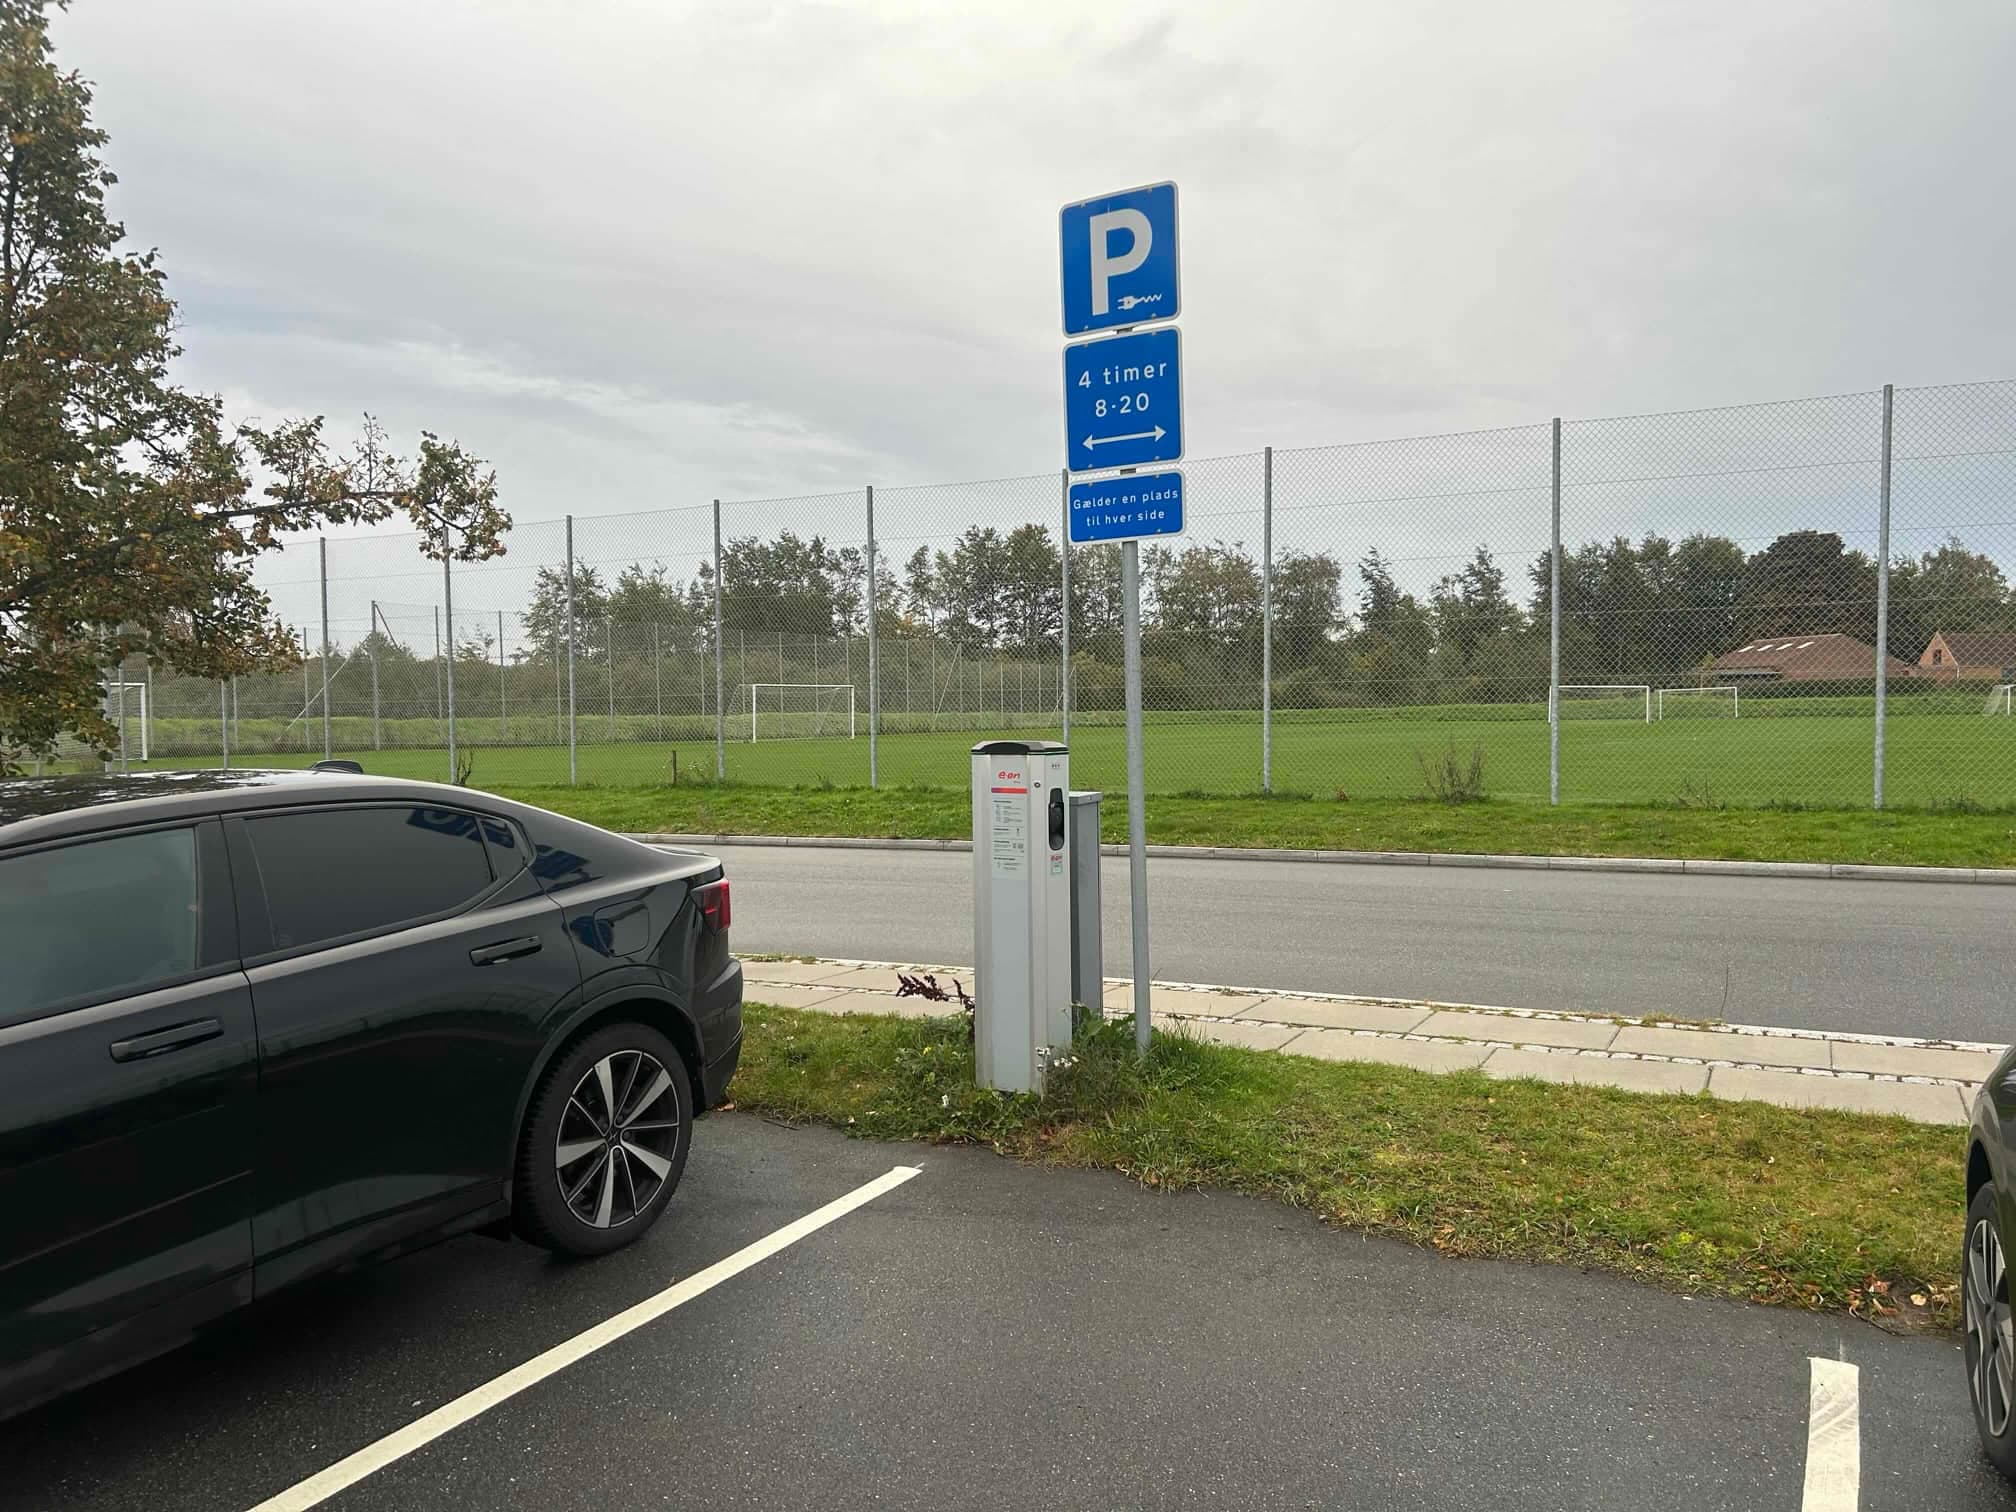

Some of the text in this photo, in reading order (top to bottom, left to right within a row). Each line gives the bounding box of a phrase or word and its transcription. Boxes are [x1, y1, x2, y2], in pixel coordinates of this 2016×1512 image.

[1090, 208, 1153, 316] P
[1078, 362, 1167, 389] 4 timer
[1073, 489, 1178, 510] Gælder en plads
[1086, 510, 1165, 527] til hver side
